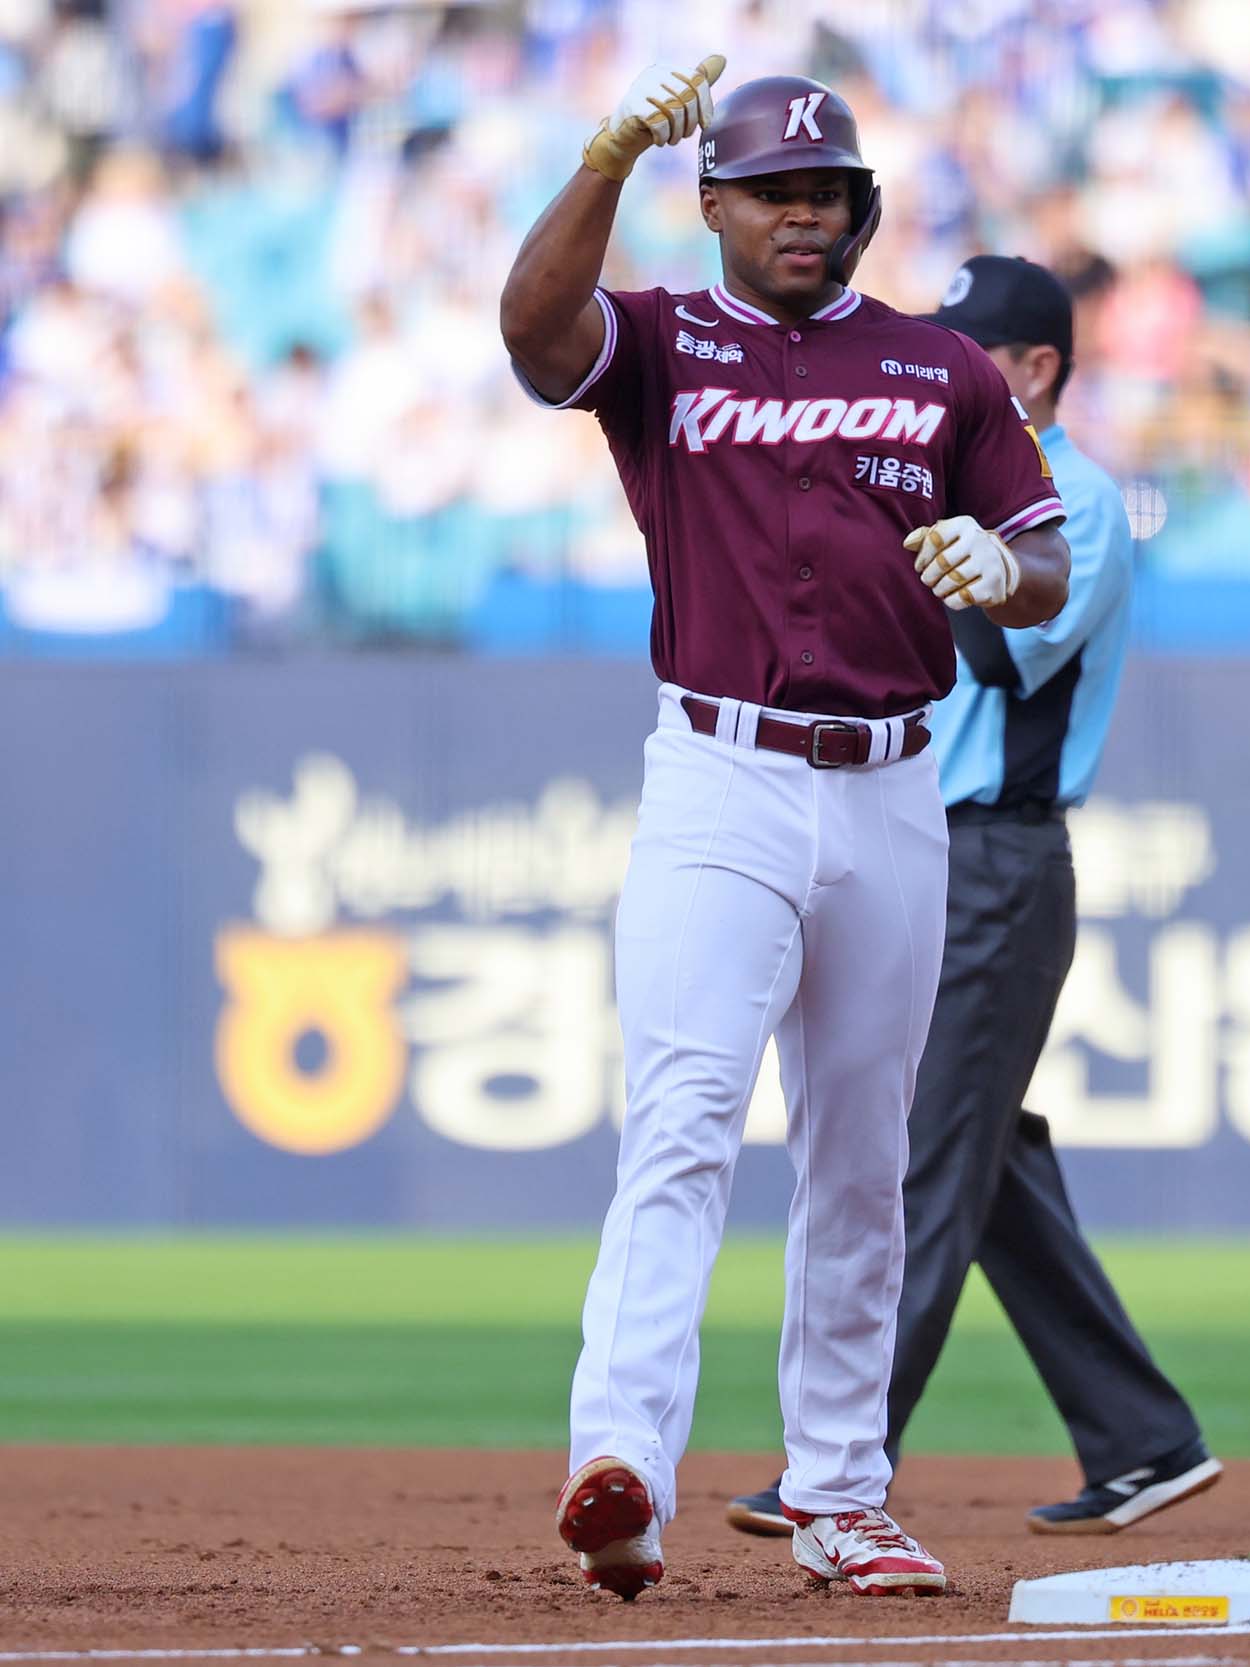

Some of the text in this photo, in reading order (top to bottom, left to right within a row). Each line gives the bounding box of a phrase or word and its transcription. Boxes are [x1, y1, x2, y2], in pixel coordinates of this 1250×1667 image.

[782, 92, 826, 142] K
[905, 363, 949, 384] 미래엔
[669, 386, 946, 453] KIWOOM
[854, 455, 933, 500] 키움증권
